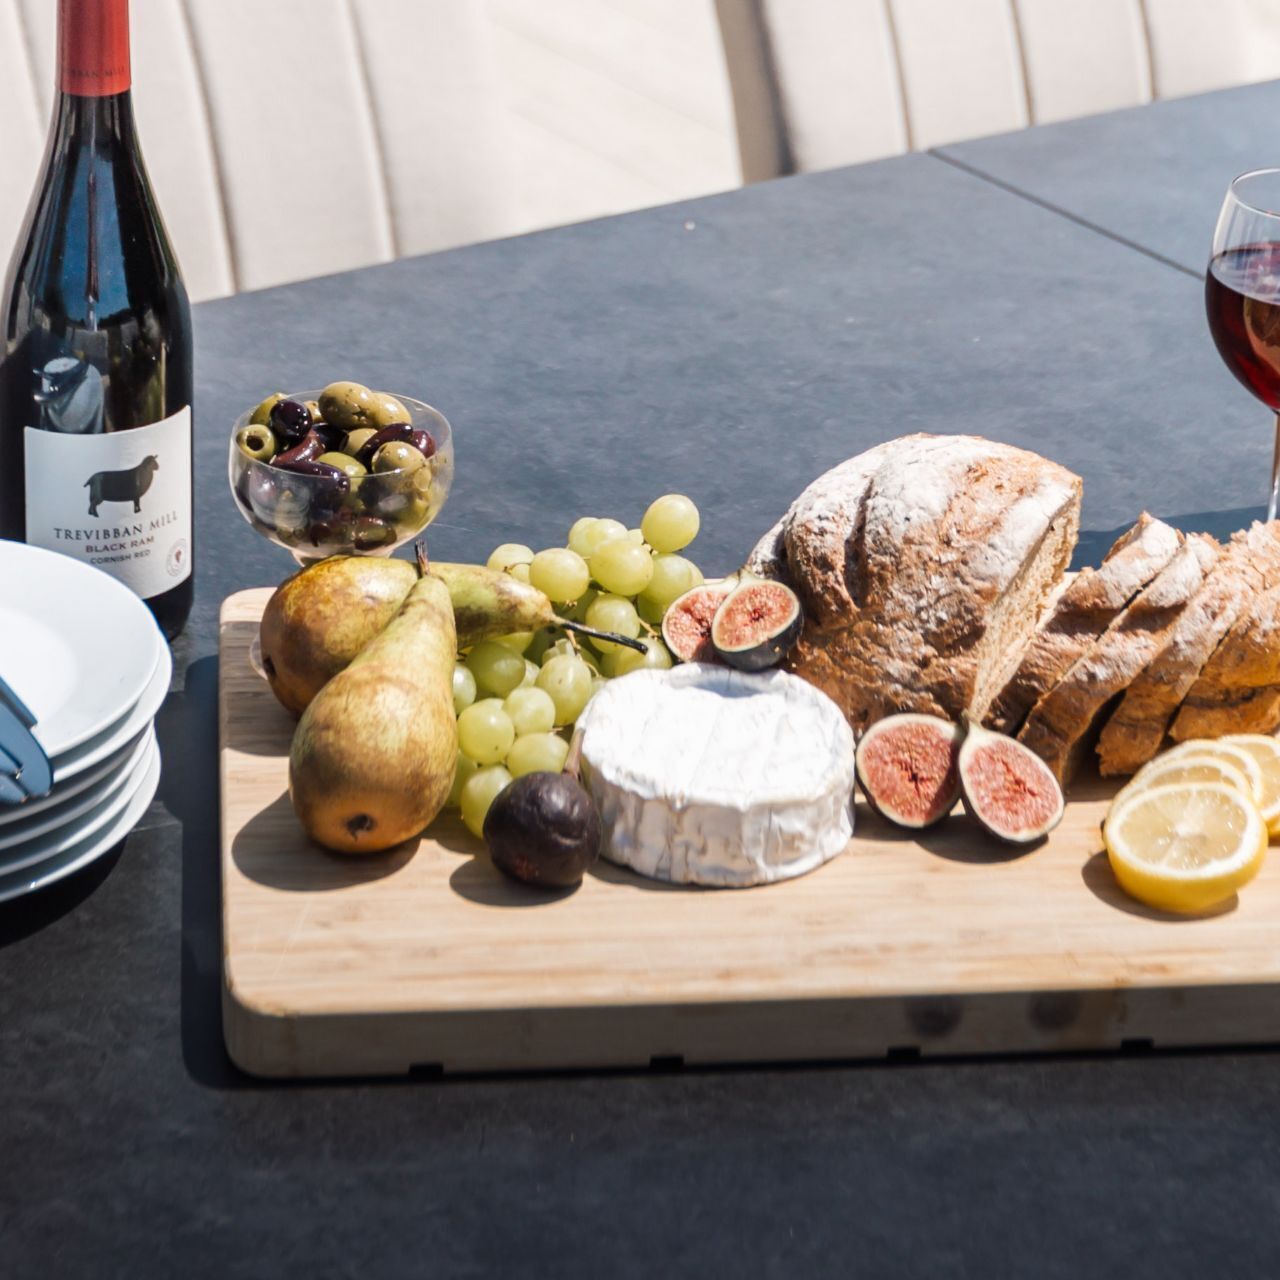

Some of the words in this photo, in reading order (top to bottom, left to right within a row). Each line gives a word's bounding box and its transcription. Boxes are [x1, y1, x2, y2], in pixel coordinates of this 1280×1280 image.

[53, 524, 143, 540] TREVIBBAN
[149, 511, 177, 531] MILL
[86, 543, 126, 553] BLACK
[130, 536, 155, 548] RAM
[90, 554, 131, 565] CORNISH
[134, 549, 151, 558] RED
